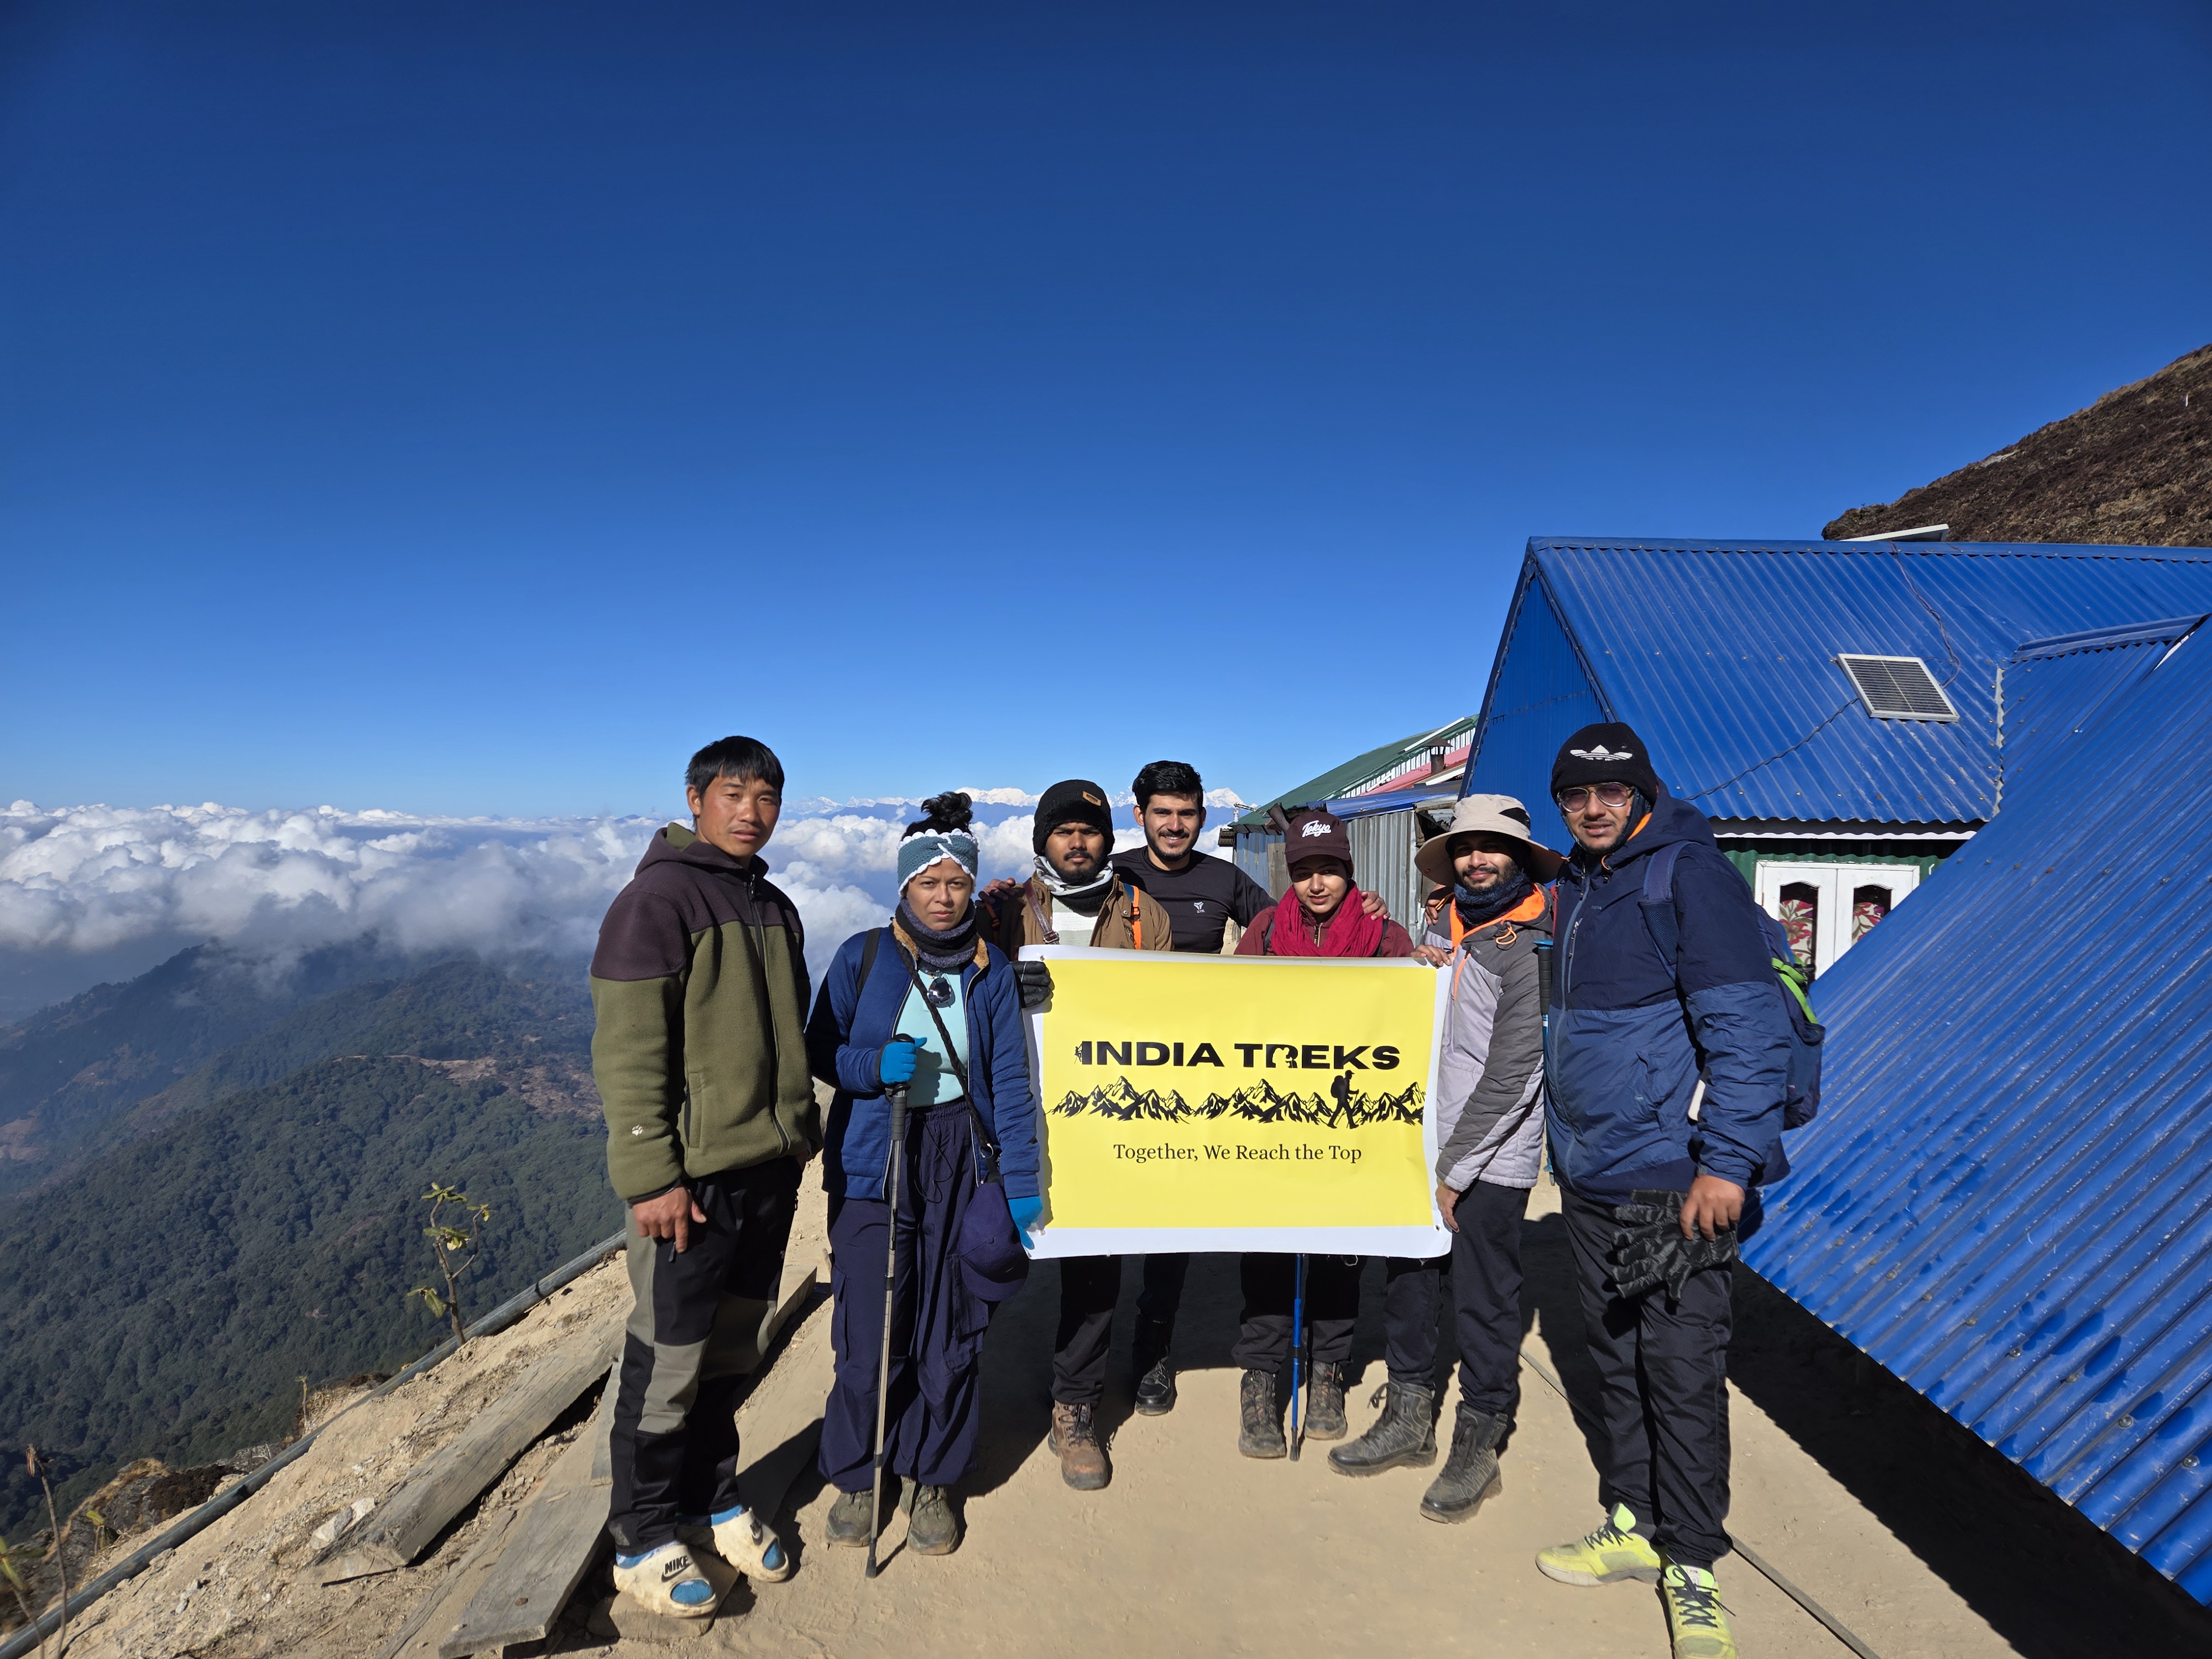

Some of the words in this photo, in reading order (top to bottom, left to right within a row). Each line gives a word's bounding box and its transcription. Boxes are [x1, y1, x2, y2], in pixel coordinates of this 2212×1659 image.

[1302, 820, 1332, 838] Tokyo
[1081, 1041, 1225, 1067] INDIA
[1234, 1043, 1400, 1070] TREKS
[1113, 1142, 1198, 1164] Together,
[1203, 1145, 1230, 1160] We
[1235, 1144, 1290, 1160] Reach
[1295, 1143, 1323, 1160] the
[1328, 1145, 1361, 1164] Top
[665, 1555, 689, 1575] NIKE
